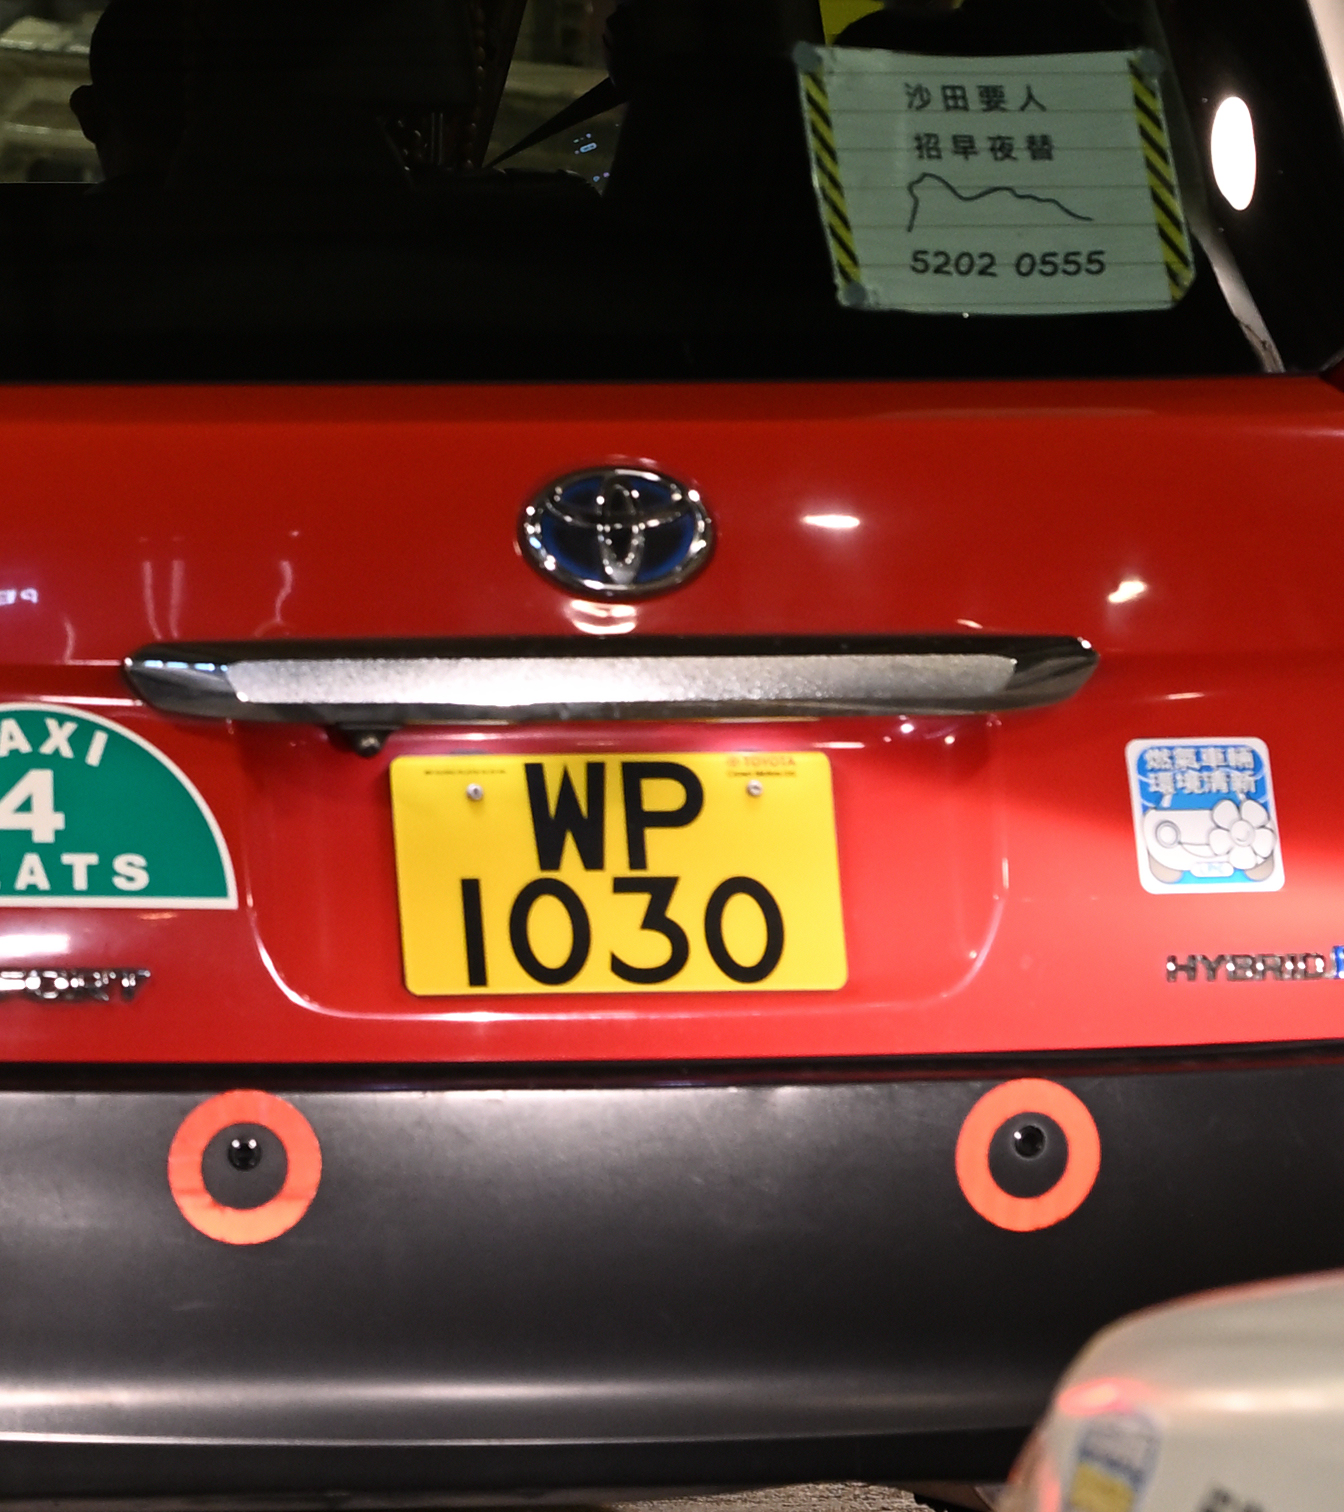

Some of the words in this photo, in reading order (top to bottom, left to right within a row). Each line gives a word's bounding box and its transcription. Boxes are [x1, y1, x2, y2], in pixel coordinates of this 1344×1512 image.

[904, 82, 1047, 112] 沙田要人
[914, 134, 1055, 161] 招早夜替
[911, 250, 998, 277] 5202
[1015, 250, 1107, 277] 0555
[523, 761, 705, 872] WP
[460, 876, 786, 988] 1030
[1166, 952, 1325, 983] HYBRID
